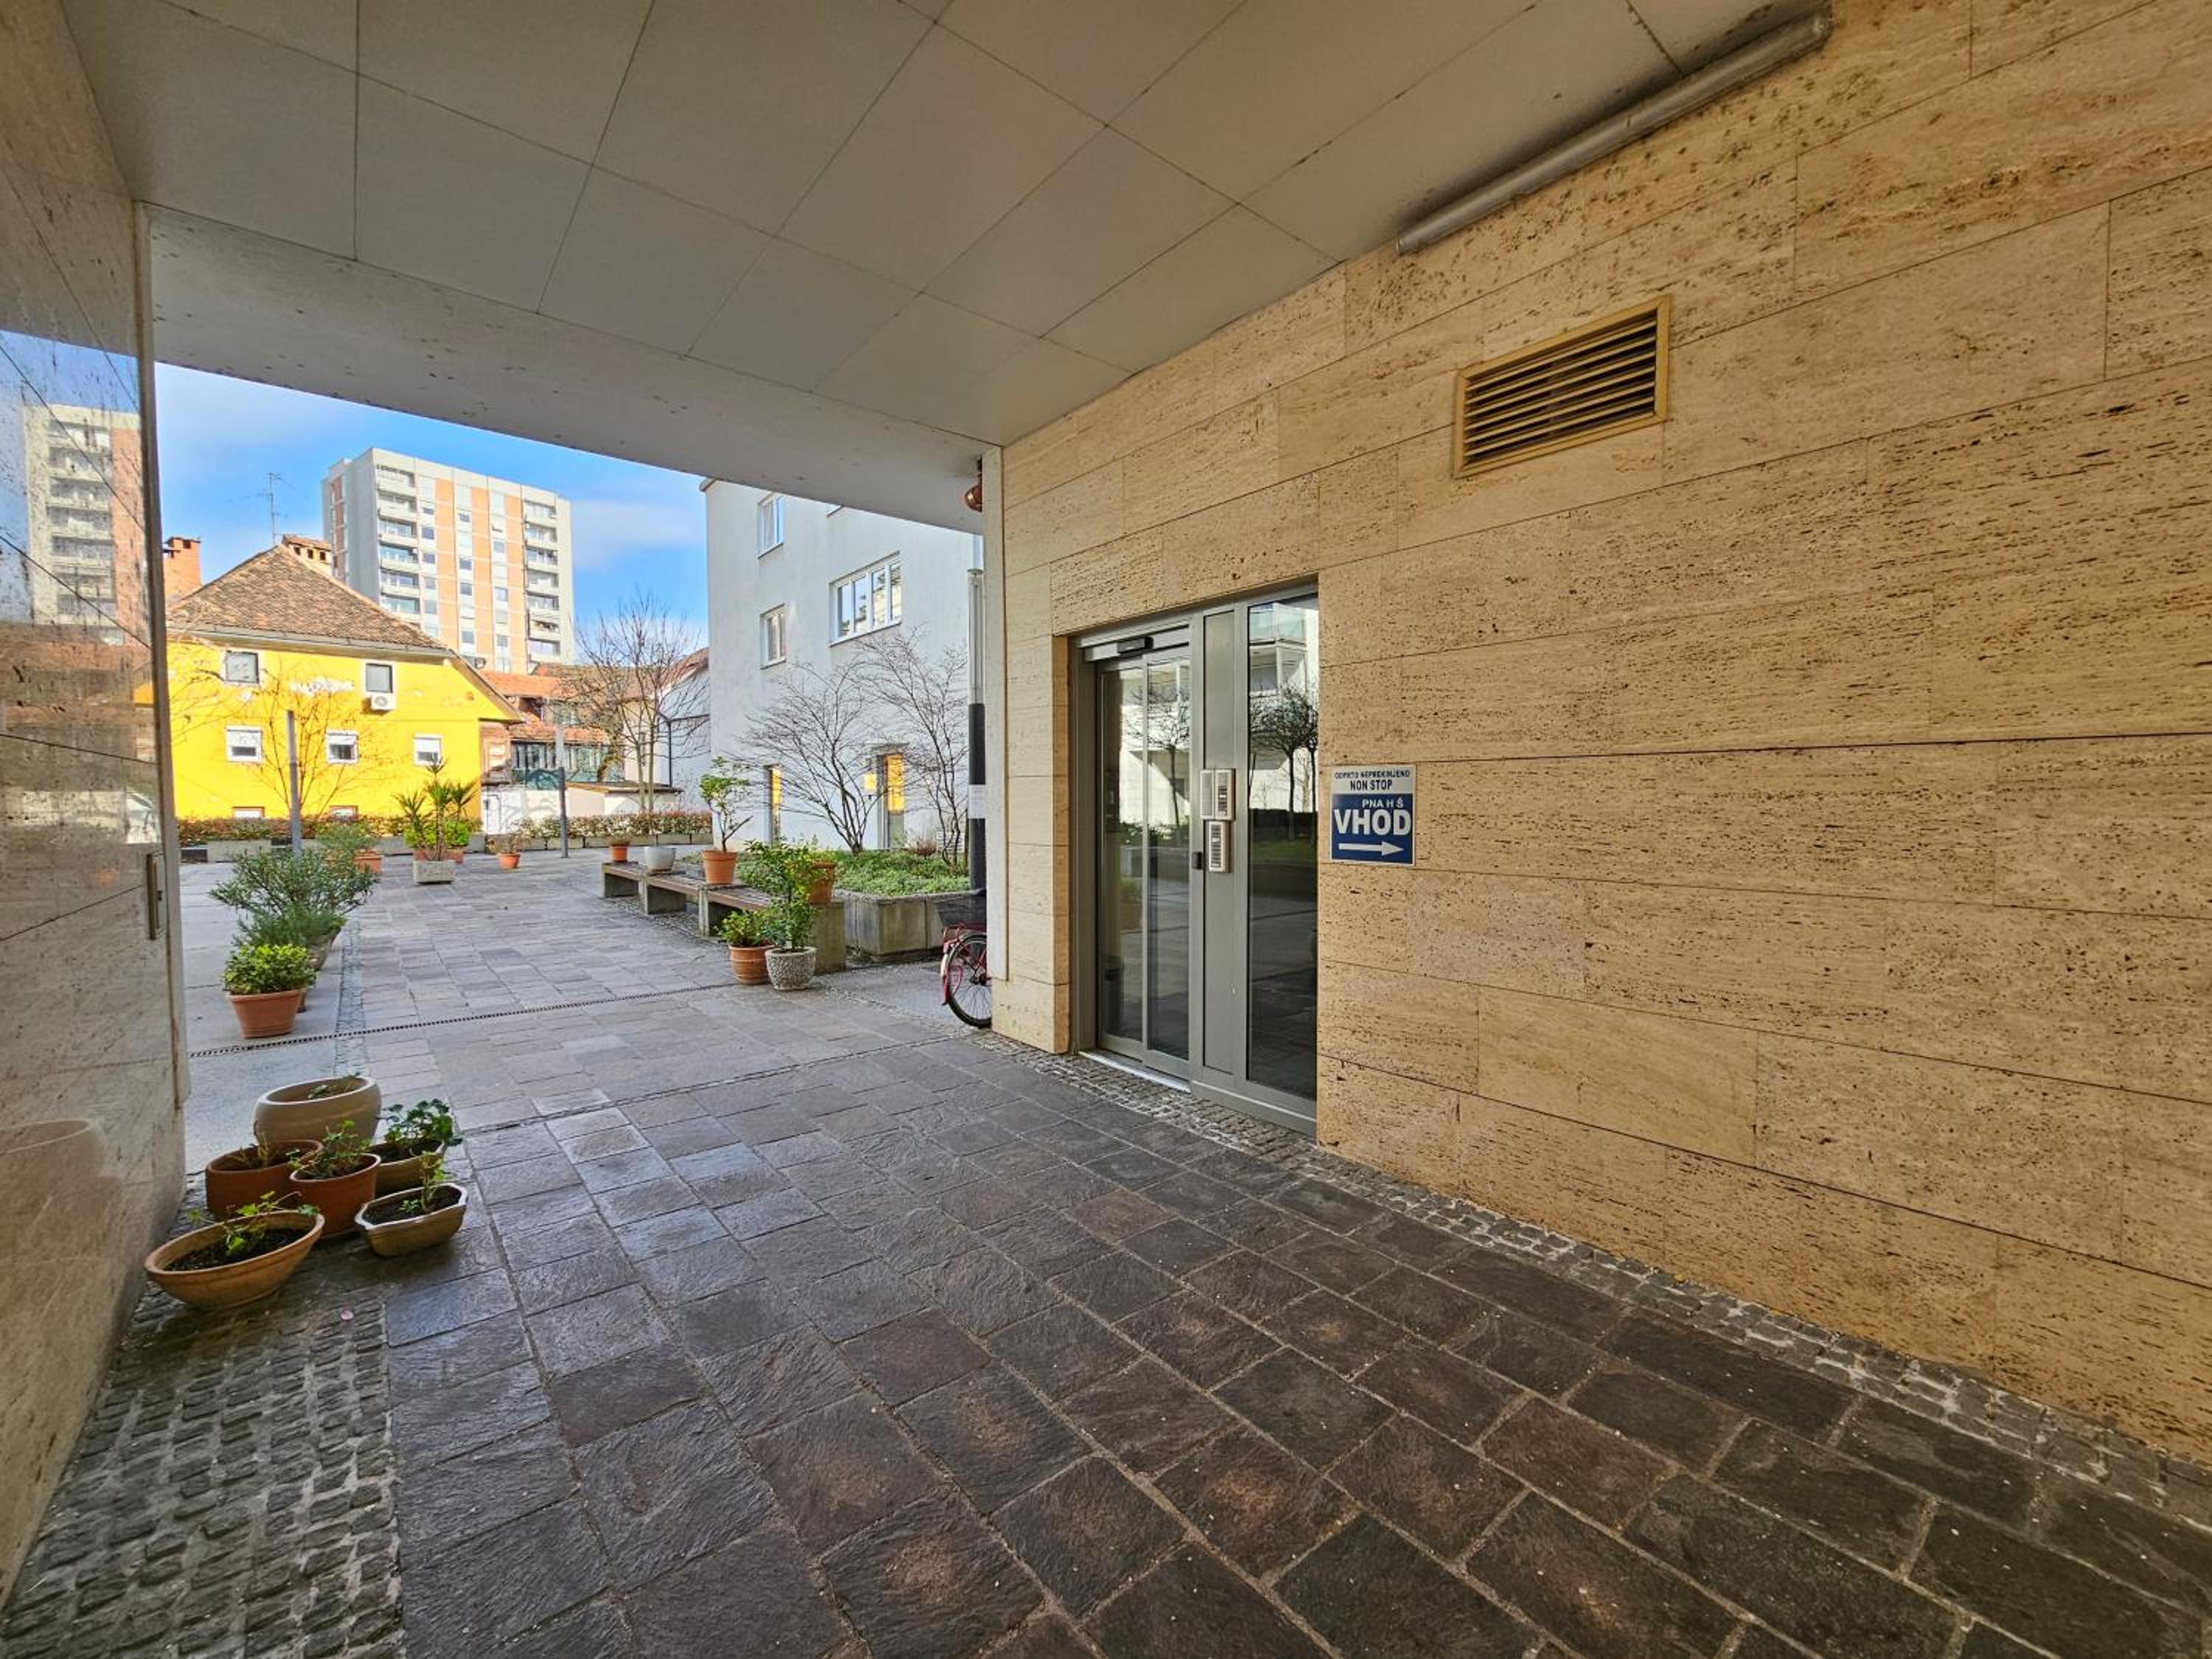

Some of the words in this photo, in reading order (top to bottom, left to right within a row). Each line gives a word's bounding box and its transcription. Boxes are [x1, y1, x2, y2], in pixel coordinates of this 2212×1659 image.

[1350, 779, 1368, 791] NON
[1369, 779, 1393, 790] STOP
[1333, 809, 1412, 835] VHOD
